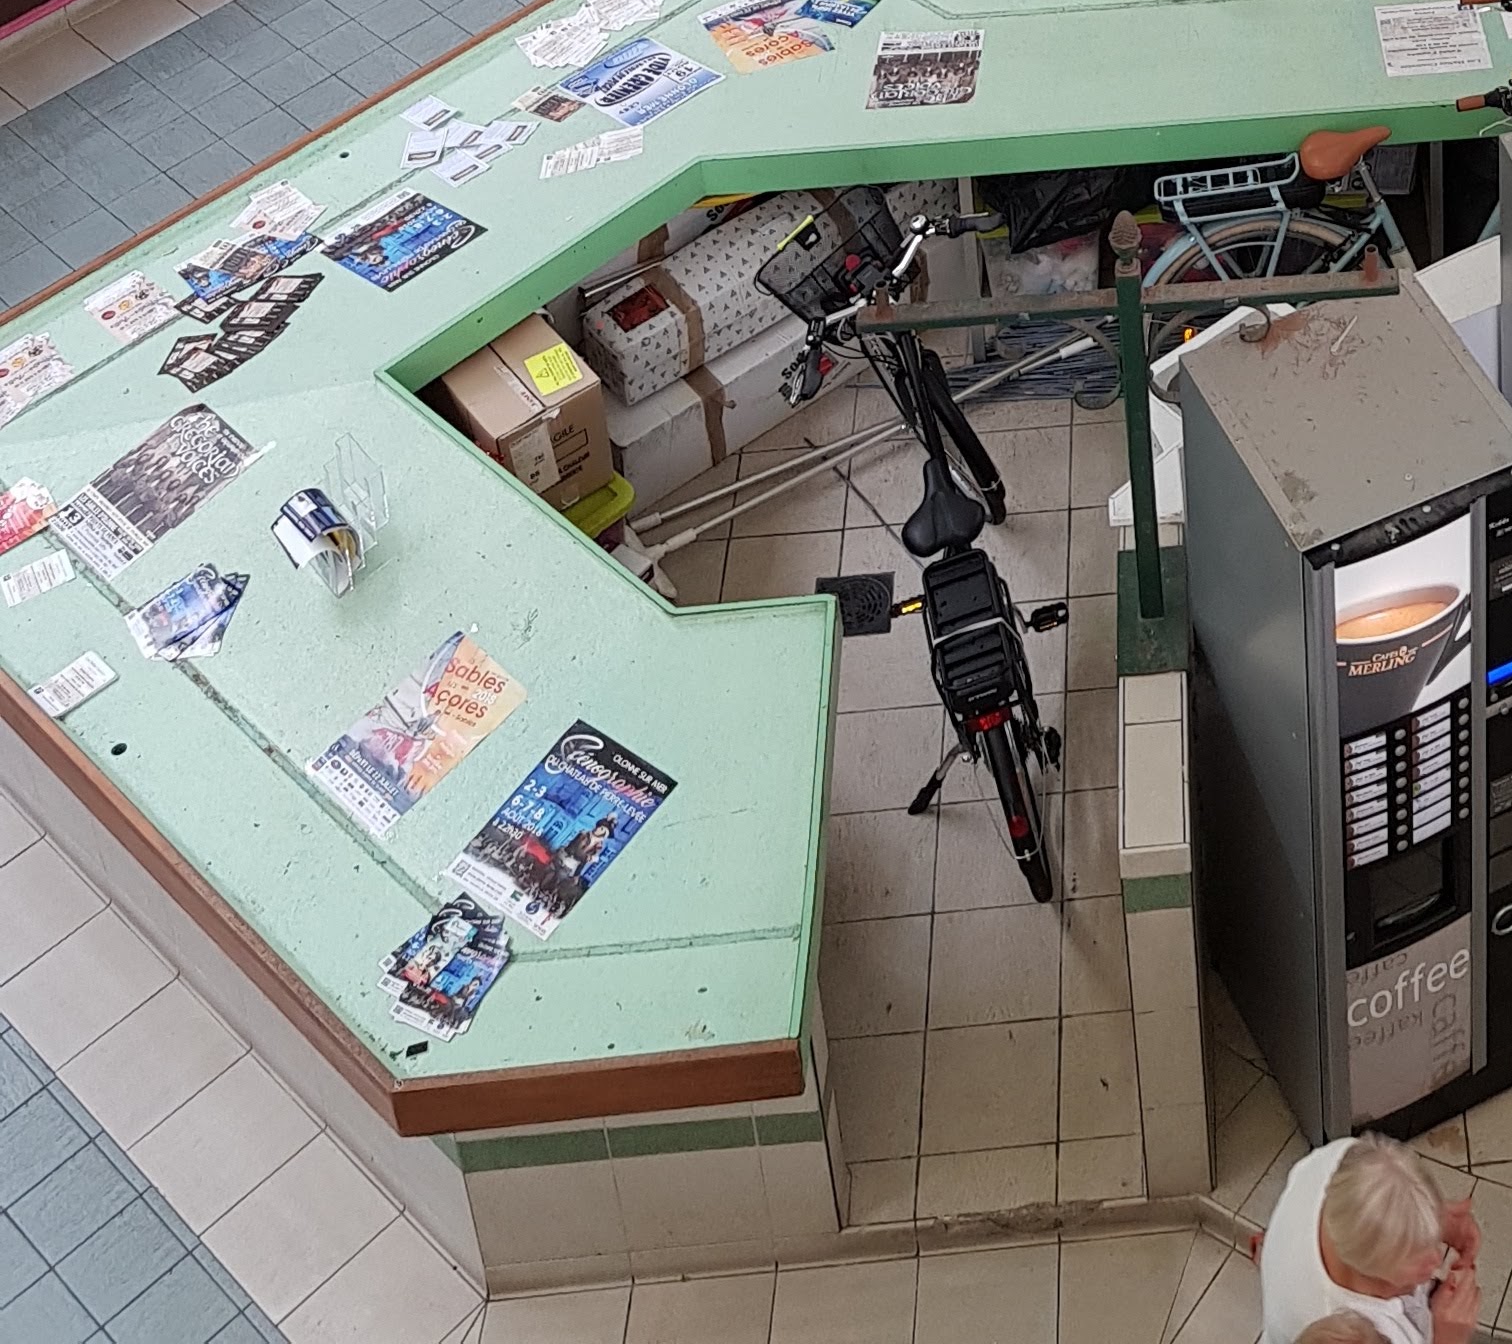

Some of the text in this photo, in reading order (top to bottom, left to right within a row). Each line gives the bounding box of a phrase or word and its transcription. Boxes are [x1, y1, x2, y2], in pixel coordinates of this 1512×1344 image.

[444, 657, 506, 695] Sables
[1347, 653, 1417, 678] MERLING
[422, 681, 489, 720] Açores
[522, 778, 548, 799] 2-3
[612, 753, 668, 794] OLONNE SUR MER
[510, 794, 545, 822] 6-7-8
[1346, 944, 1472, 1029] coffee
